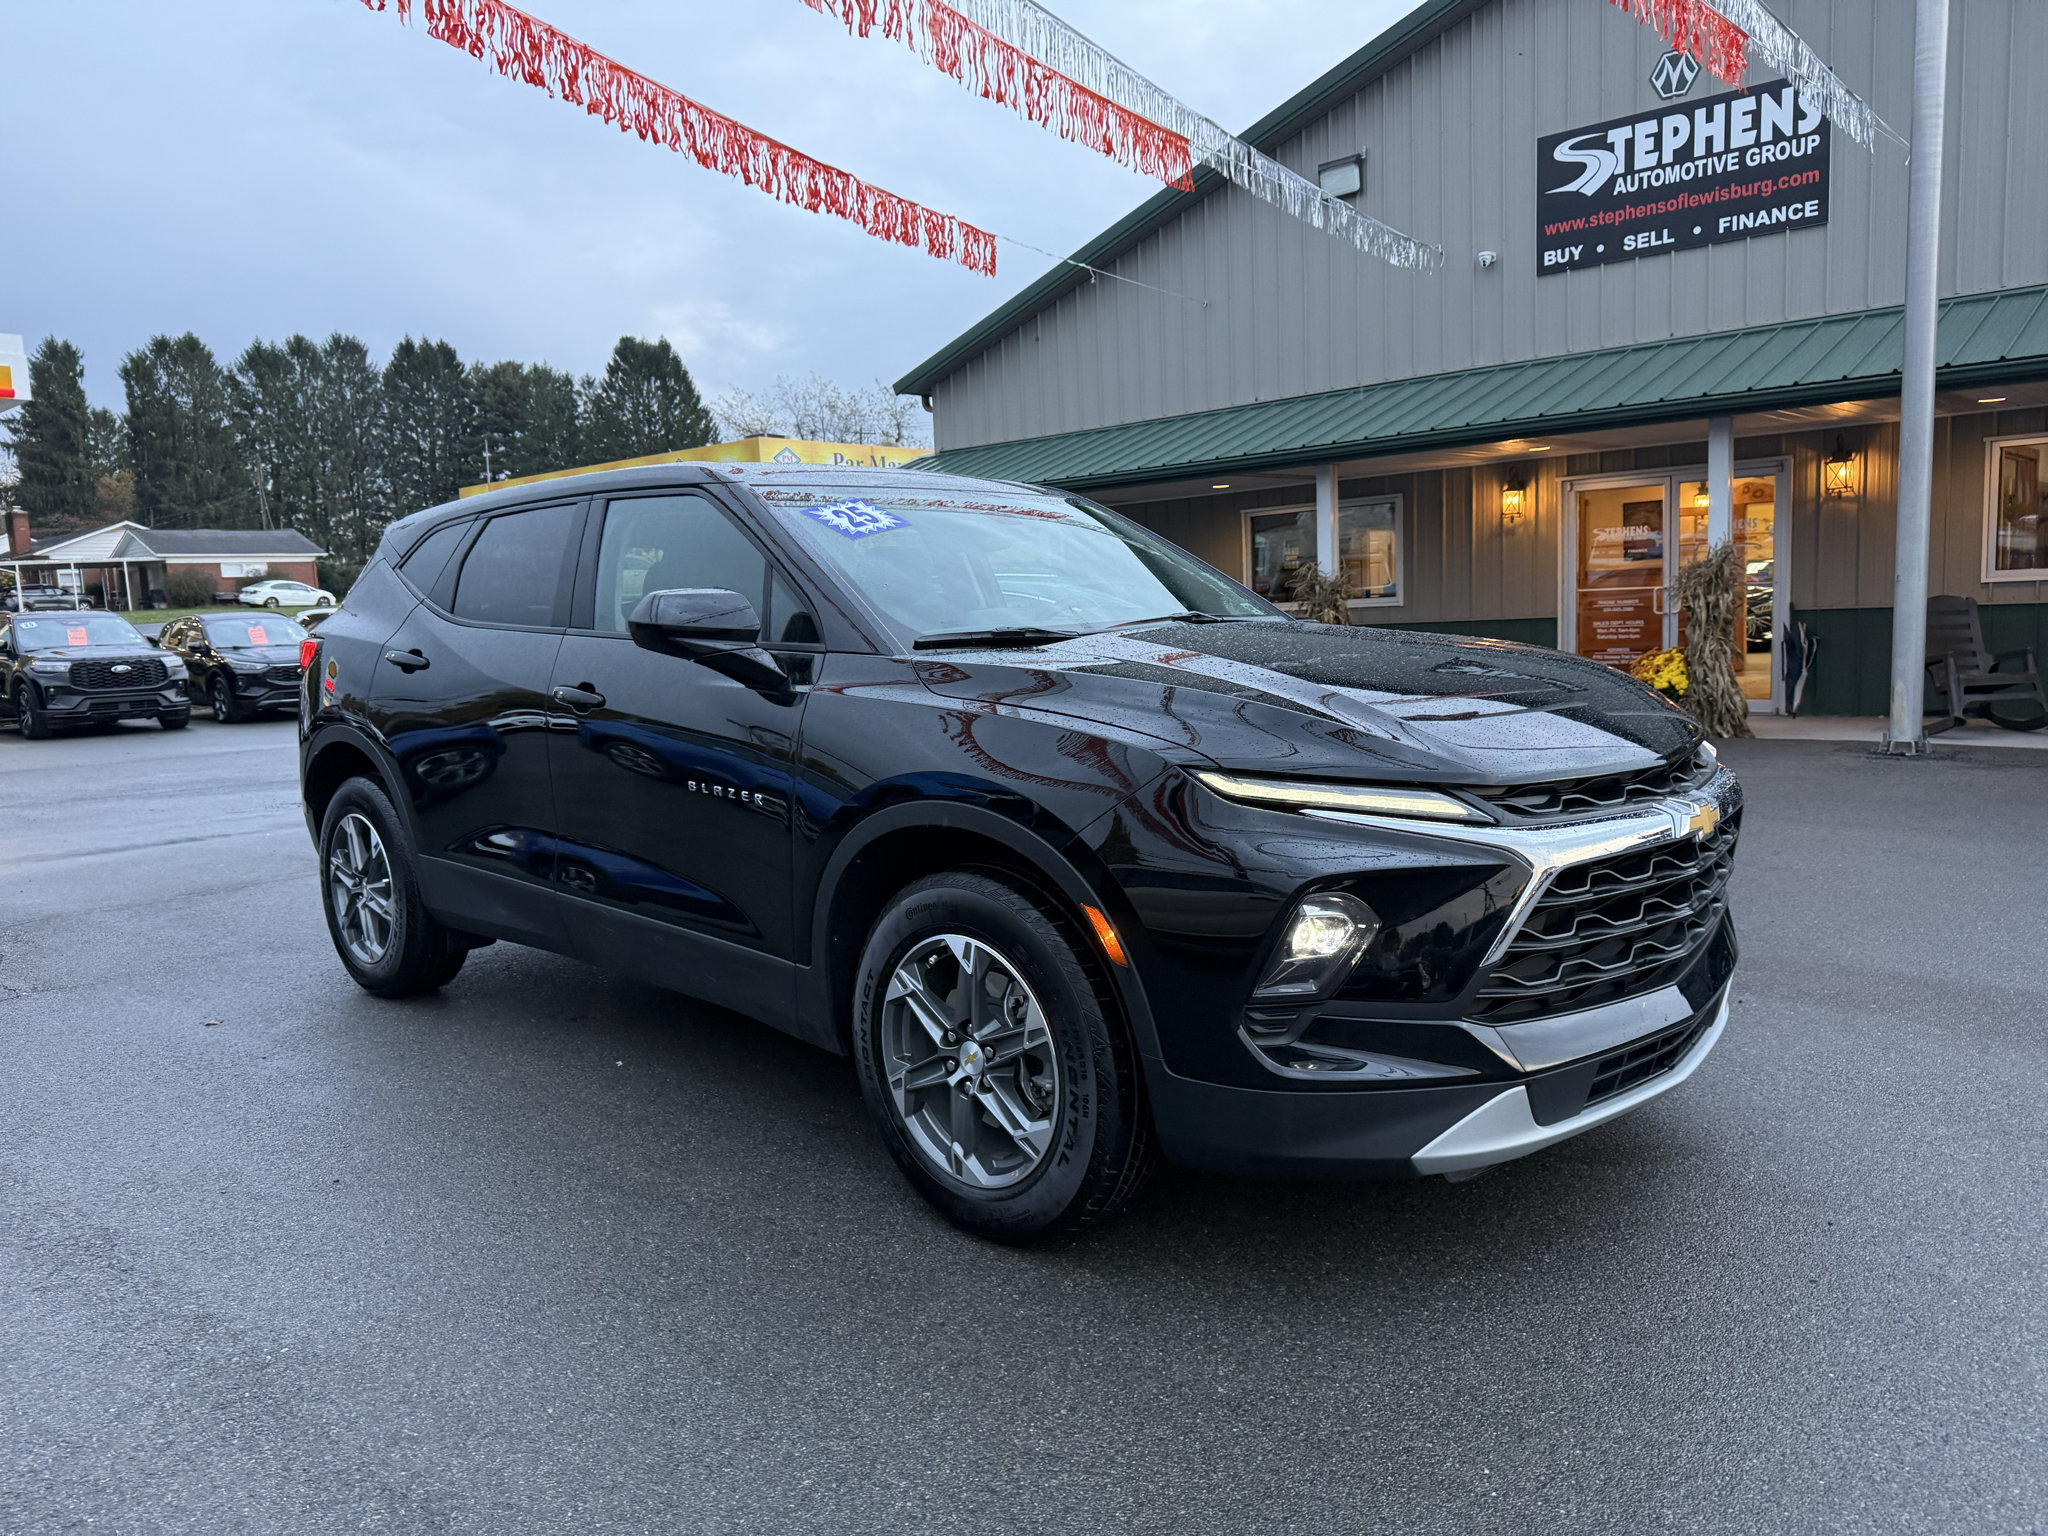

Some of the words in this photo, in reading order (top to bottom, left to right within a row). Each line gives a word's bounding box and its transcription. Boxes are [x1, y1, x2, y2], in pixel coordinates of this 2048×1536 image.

[1544, 86, 1822, 197] STEPHENS
[1612, 152, 1739, 196] AUTOMOTIVE
[1745, 134, 1821, 167] GROUP
[1544, 169, 1820, 236] www.stephensoflewisburg.com
[1543, 244, 1584, 267] BUY
[1622, 228, 1675, 251] SELL
[1718, 200, 1819, 234] FINANCE
[782, 454, 793, 463] PM
[833, 452, 864, 466] Par
[832, 506, 880, 528] 25
[687, 780, 763, 806] BLAZER
